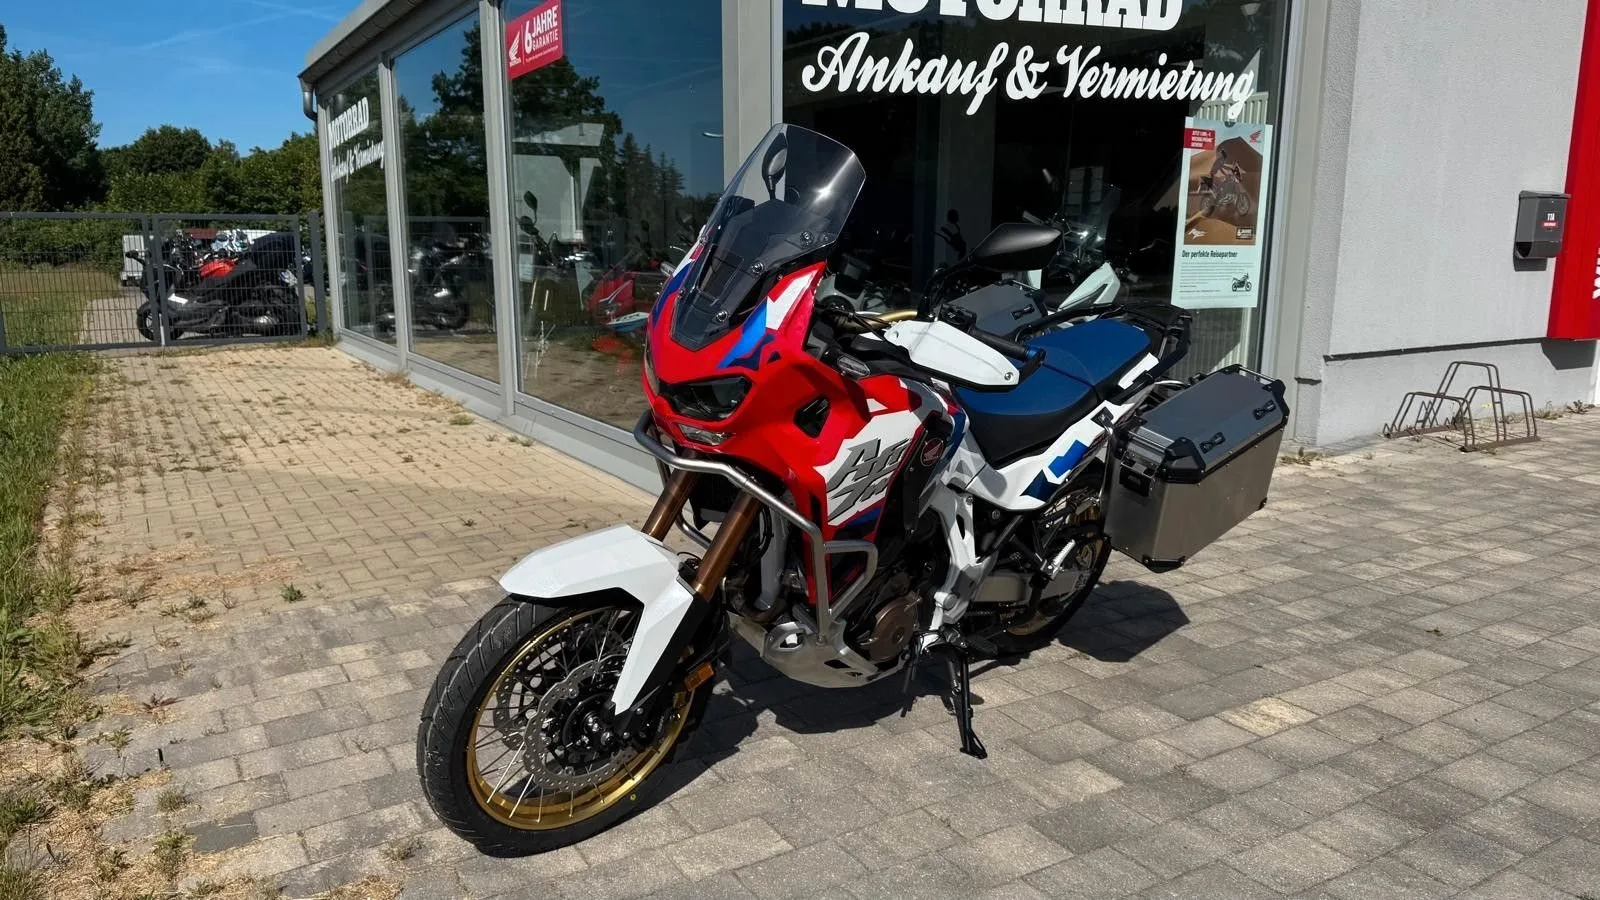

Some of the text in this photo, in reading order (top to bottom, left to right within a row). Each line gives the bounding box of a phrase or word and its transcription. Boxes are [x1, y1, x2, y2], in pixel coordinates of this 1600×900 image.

[524, 20, 533, 54] 6
[532, 4, 558, 38] JAHRE
[532, 28, 558, 51] GARANTIE
[802, 32, 1254, 119] Ankauf & Vermietung
[328, 96, 369, 150] MOTORRAD
[1182, 250, 1190, 258] Der
